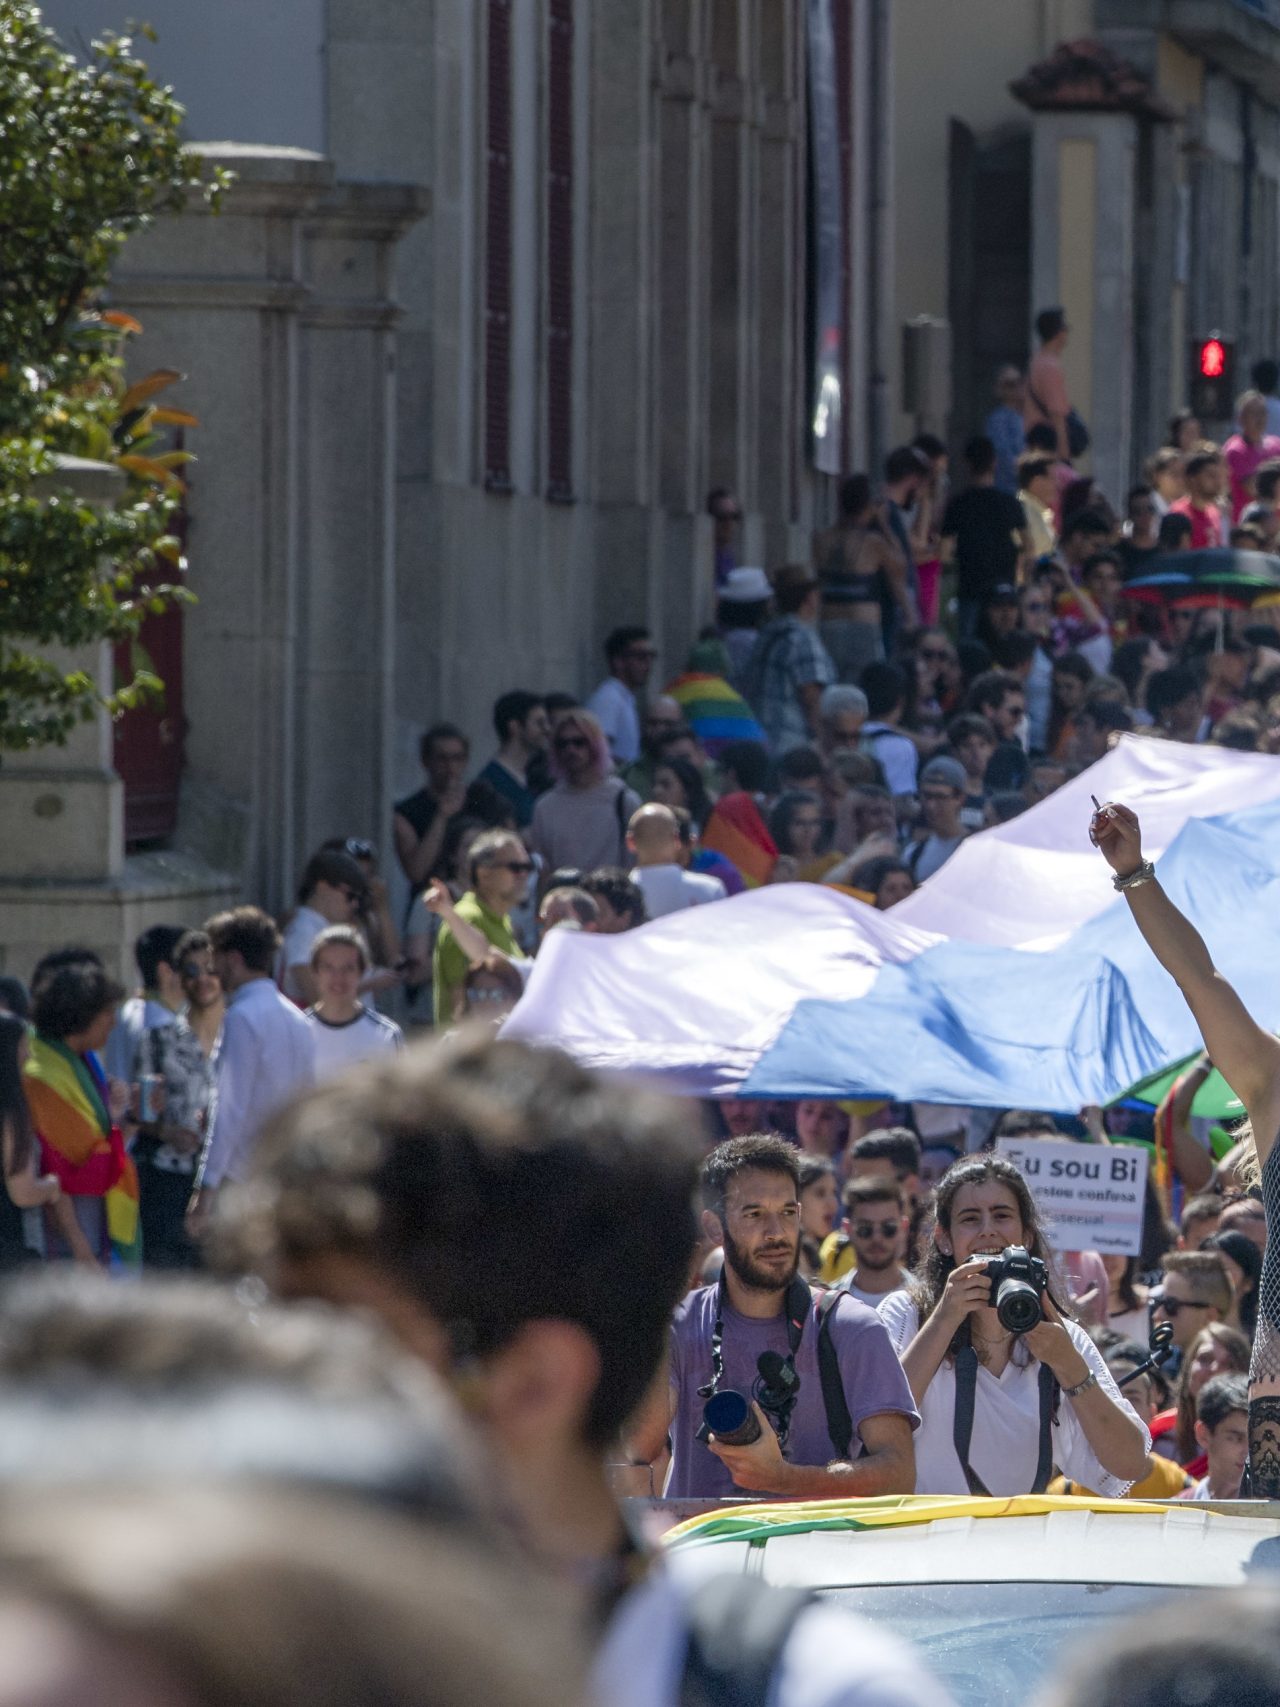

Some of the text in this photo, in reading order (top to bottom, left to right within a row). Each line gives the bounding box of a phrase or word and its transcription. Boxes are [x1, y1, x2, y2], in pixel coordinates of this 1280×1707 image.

[1049, 1159, 1100, 1179] sou
[1110, 1157, 1137, 1182] Bi
[1077, 1189, 1137, 1203] confusa
